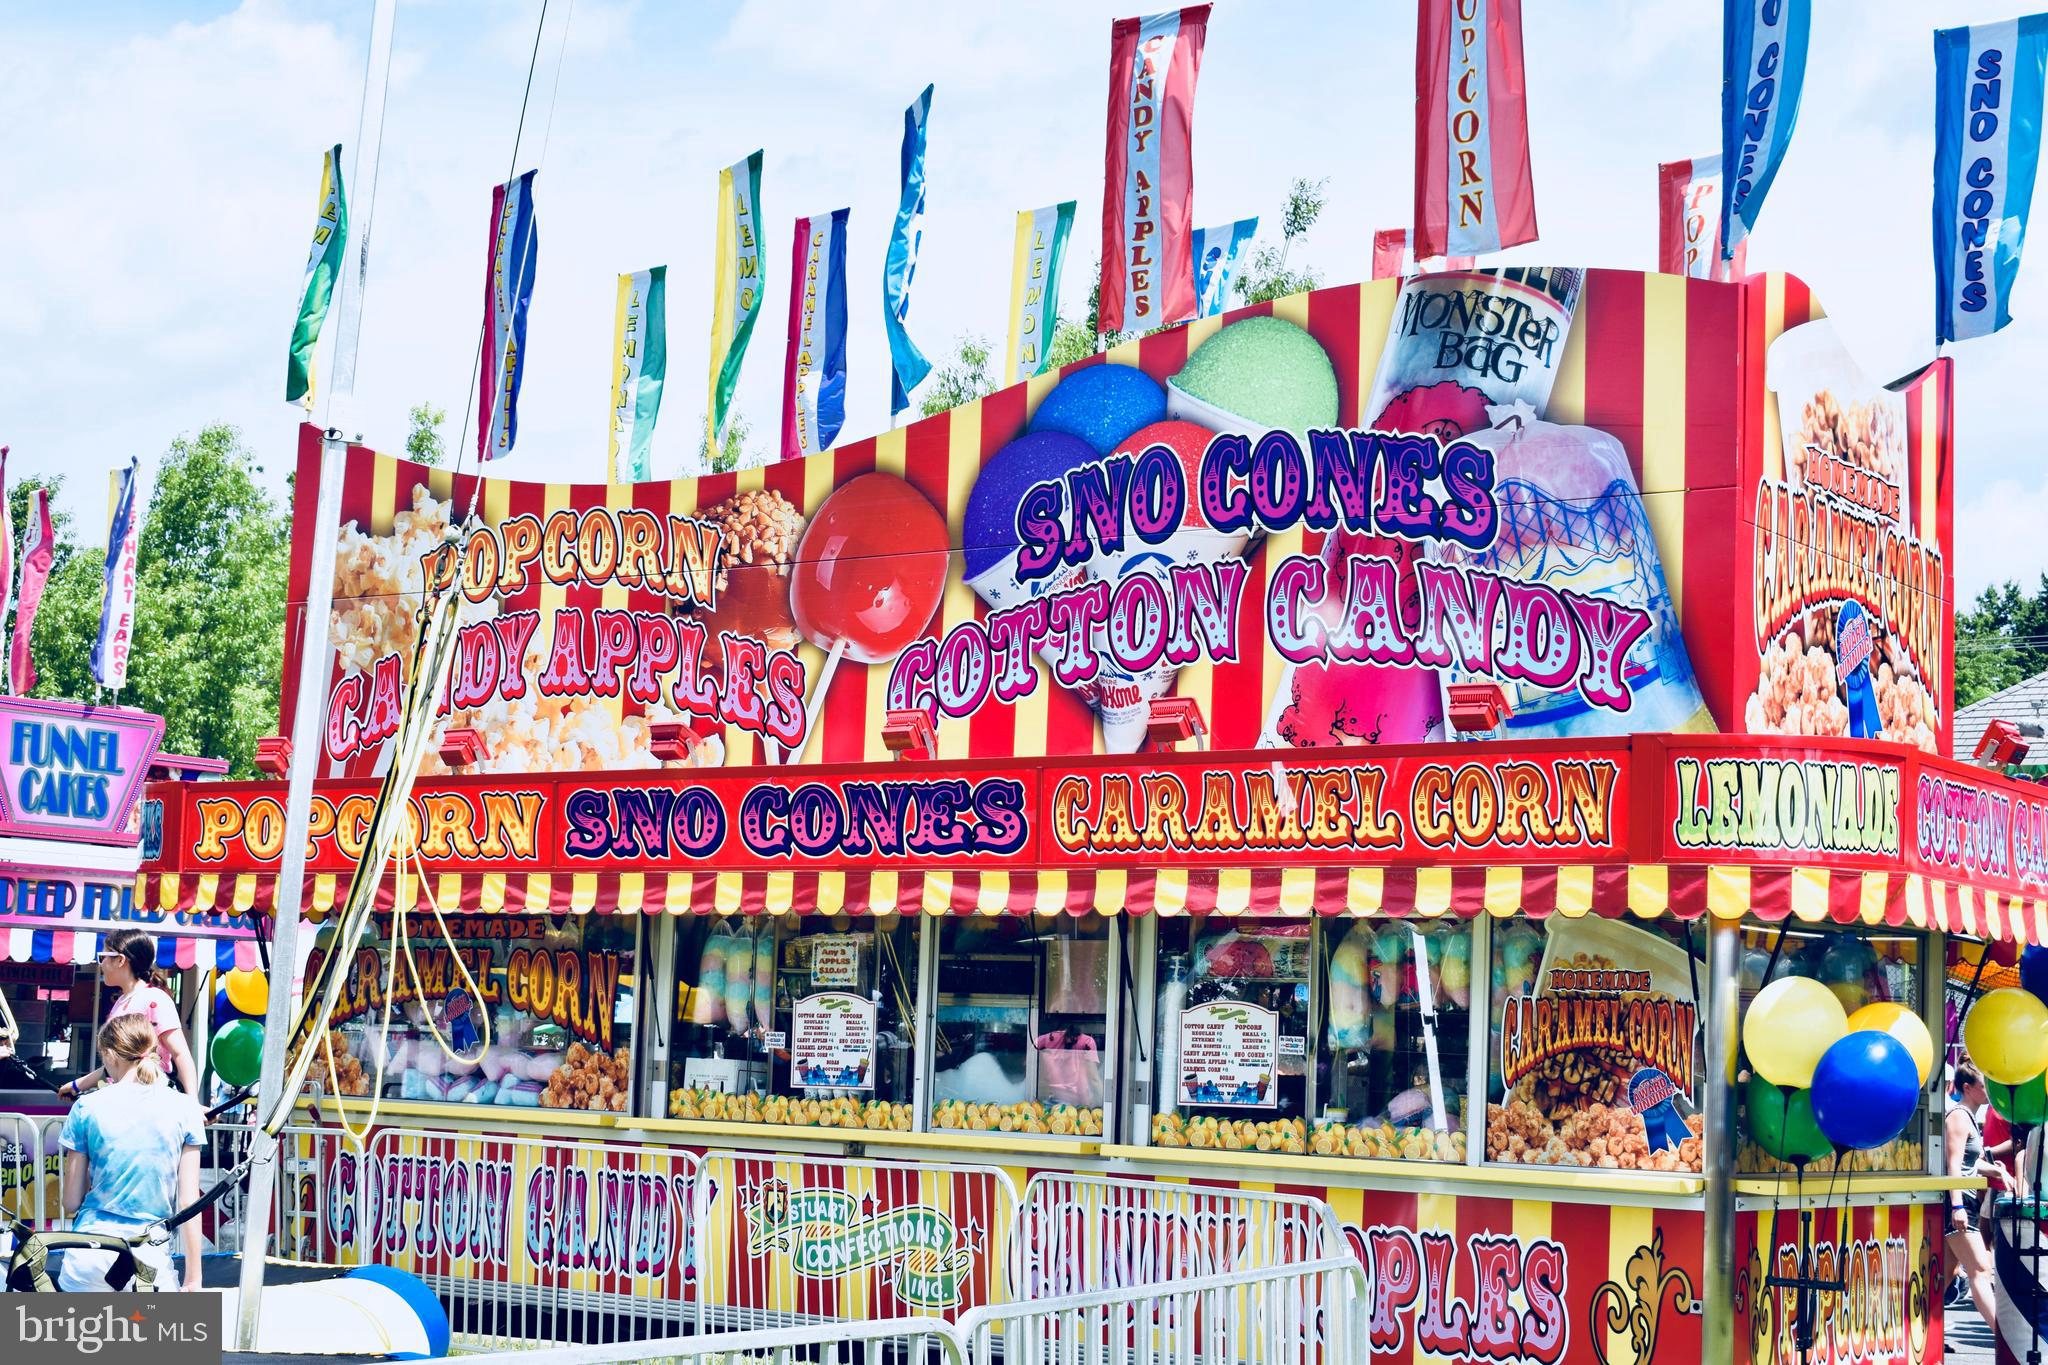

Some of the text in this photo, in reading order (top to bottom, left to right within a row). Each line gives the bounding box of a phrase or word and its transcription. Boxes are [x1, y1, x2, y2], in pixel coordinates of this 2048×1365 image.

[1131, 35, 1166, 319] CANDY APPLES
[1959, 49, 2003, 312] SNO CONES
[736, 193, 757, 337] LEMO
[1020, 229, 1045, 378] LEMON
[797, 230, 825, 450] CARAMEL APPLES
[1016, 427, 1499, 582] SNO CONES
[1806, 446, 1901, 522] HOMEMADE
[416, 508, 728, 622] POPCORN
[1755, 477, 1944, 726] CARAMEL CORN
[326, 608, 809, 763] CADY APPLES
[887, 556, 1654, 722] COTTON CANDY
[10, 720, 124, 776] FUNNEL
[19, 767, 110, 821] CAKES
[566, 781, 1031, 861] SNO CONES
[1053, 760, 1621, 852] CARAMEL CORN
[1675, 757, 1900, 857] LEMONADE
[1917, 774, 2010, 877] COTTON
[379, 918, 546, 940] HOMEMADE
[1550, 969, 1651, 991] HOMEMADE
[507, 946, 620, 1058] CORN
[1503, 996, 1695, 1106] CARAMEL CORN
[1631, 1084, 1676, 1115] WINNING!
[1634, 1077, 1667, 1104] AWARD
[329, 1152, 719, 1284] COTTON CANDY
[790, 1201, 848, 1222] STUART
[806, 1218, 945, 1270] CONFECTIONS
[910, 1277, 948, 1299] INC.
